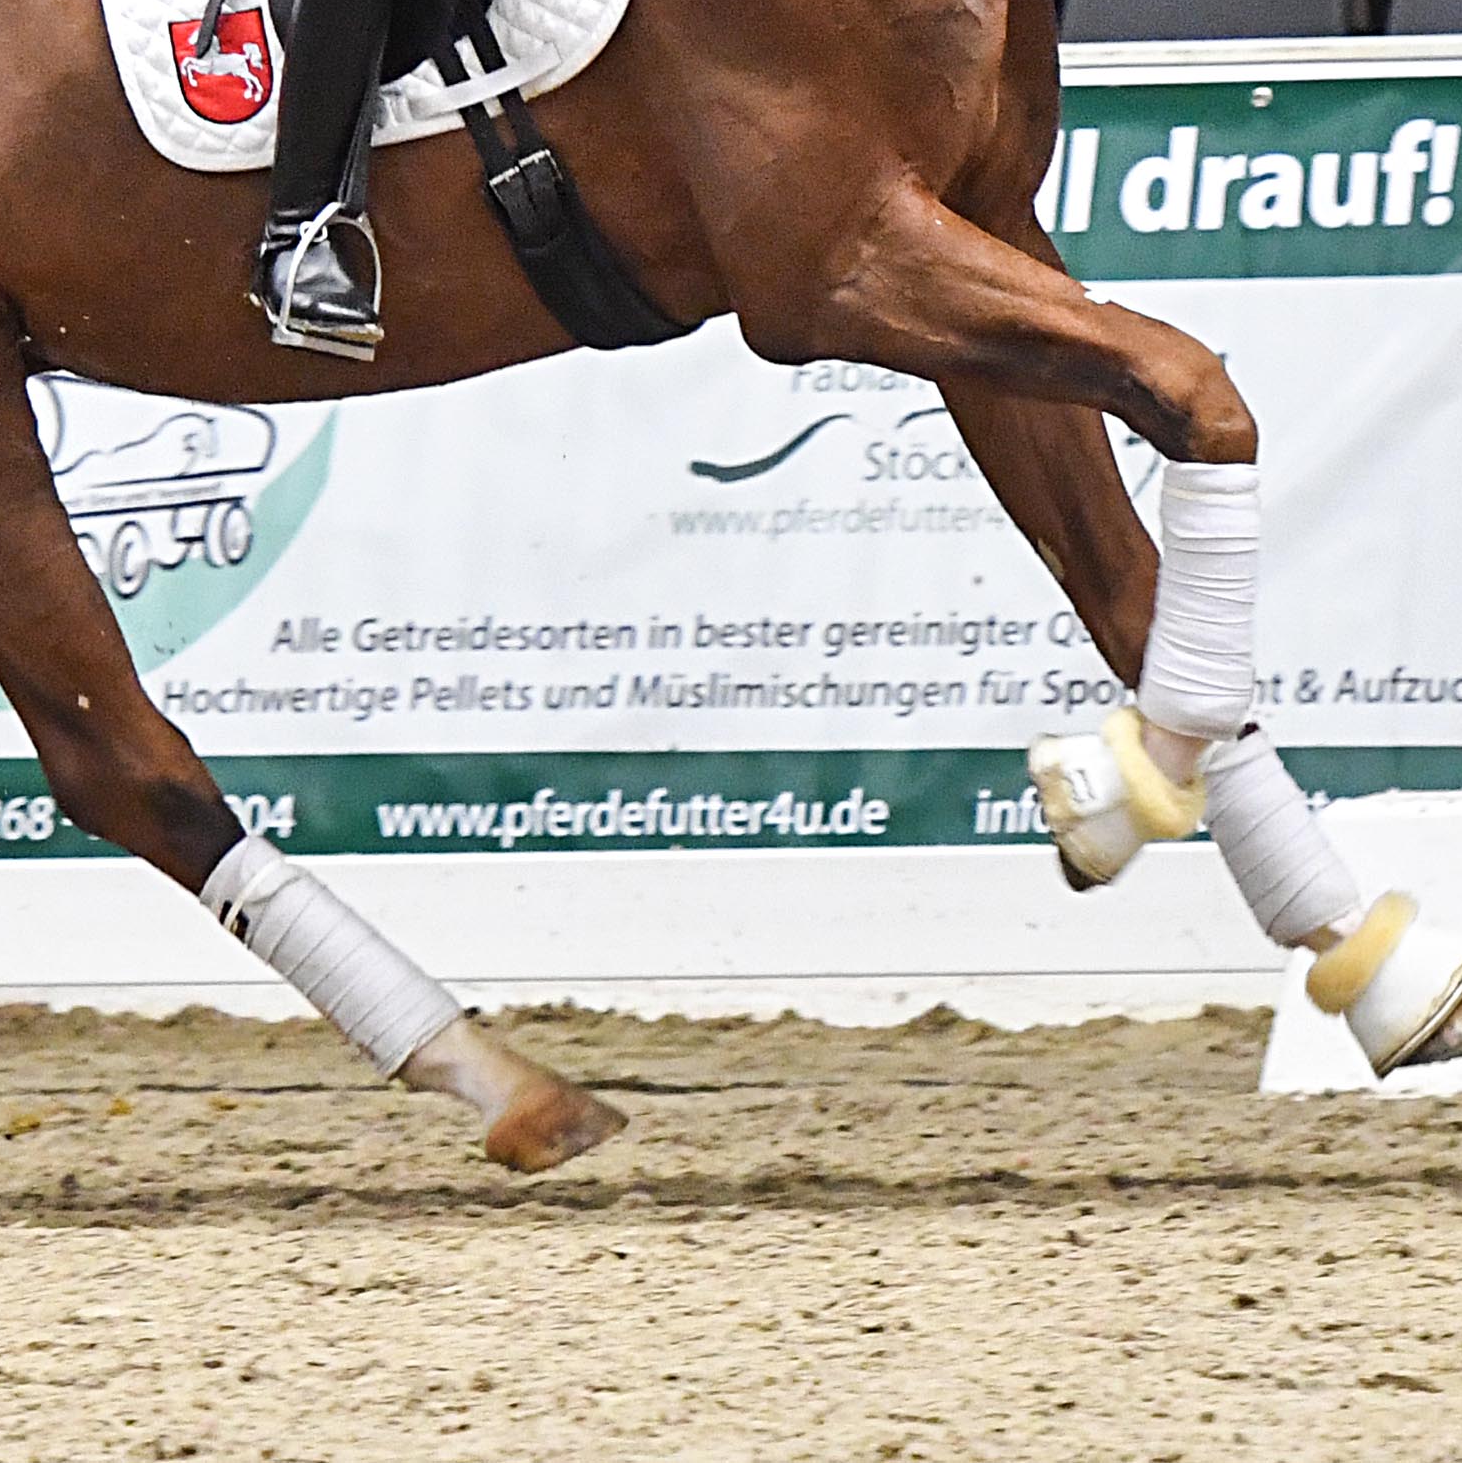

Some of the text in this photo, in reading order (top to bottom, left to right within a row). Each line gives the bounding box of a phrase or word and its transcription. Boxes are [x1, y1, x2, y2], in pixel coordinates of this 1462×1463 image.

[1119, 118, 1462, 233] drauf!
[270, 618, 339, 653] Alle
[353, 616, 637, 653] Getreidesorten
[648, 616, 683, 648] in
[694, 614, 815, 648] bester
[823, 611, 1038, 657] gereinigter
[161, 677, 398, 721] Hochwertige
[410, 673, 534, 711] Pellets
[544, 674, 619, 708] und
[627, 671, 968, 716] Müslimischungen
[977, 670, 1030, 705] für
[1296, 670, 1323, 704] &
[375, 788, 890, 849] www.pferdefutter4u.de
